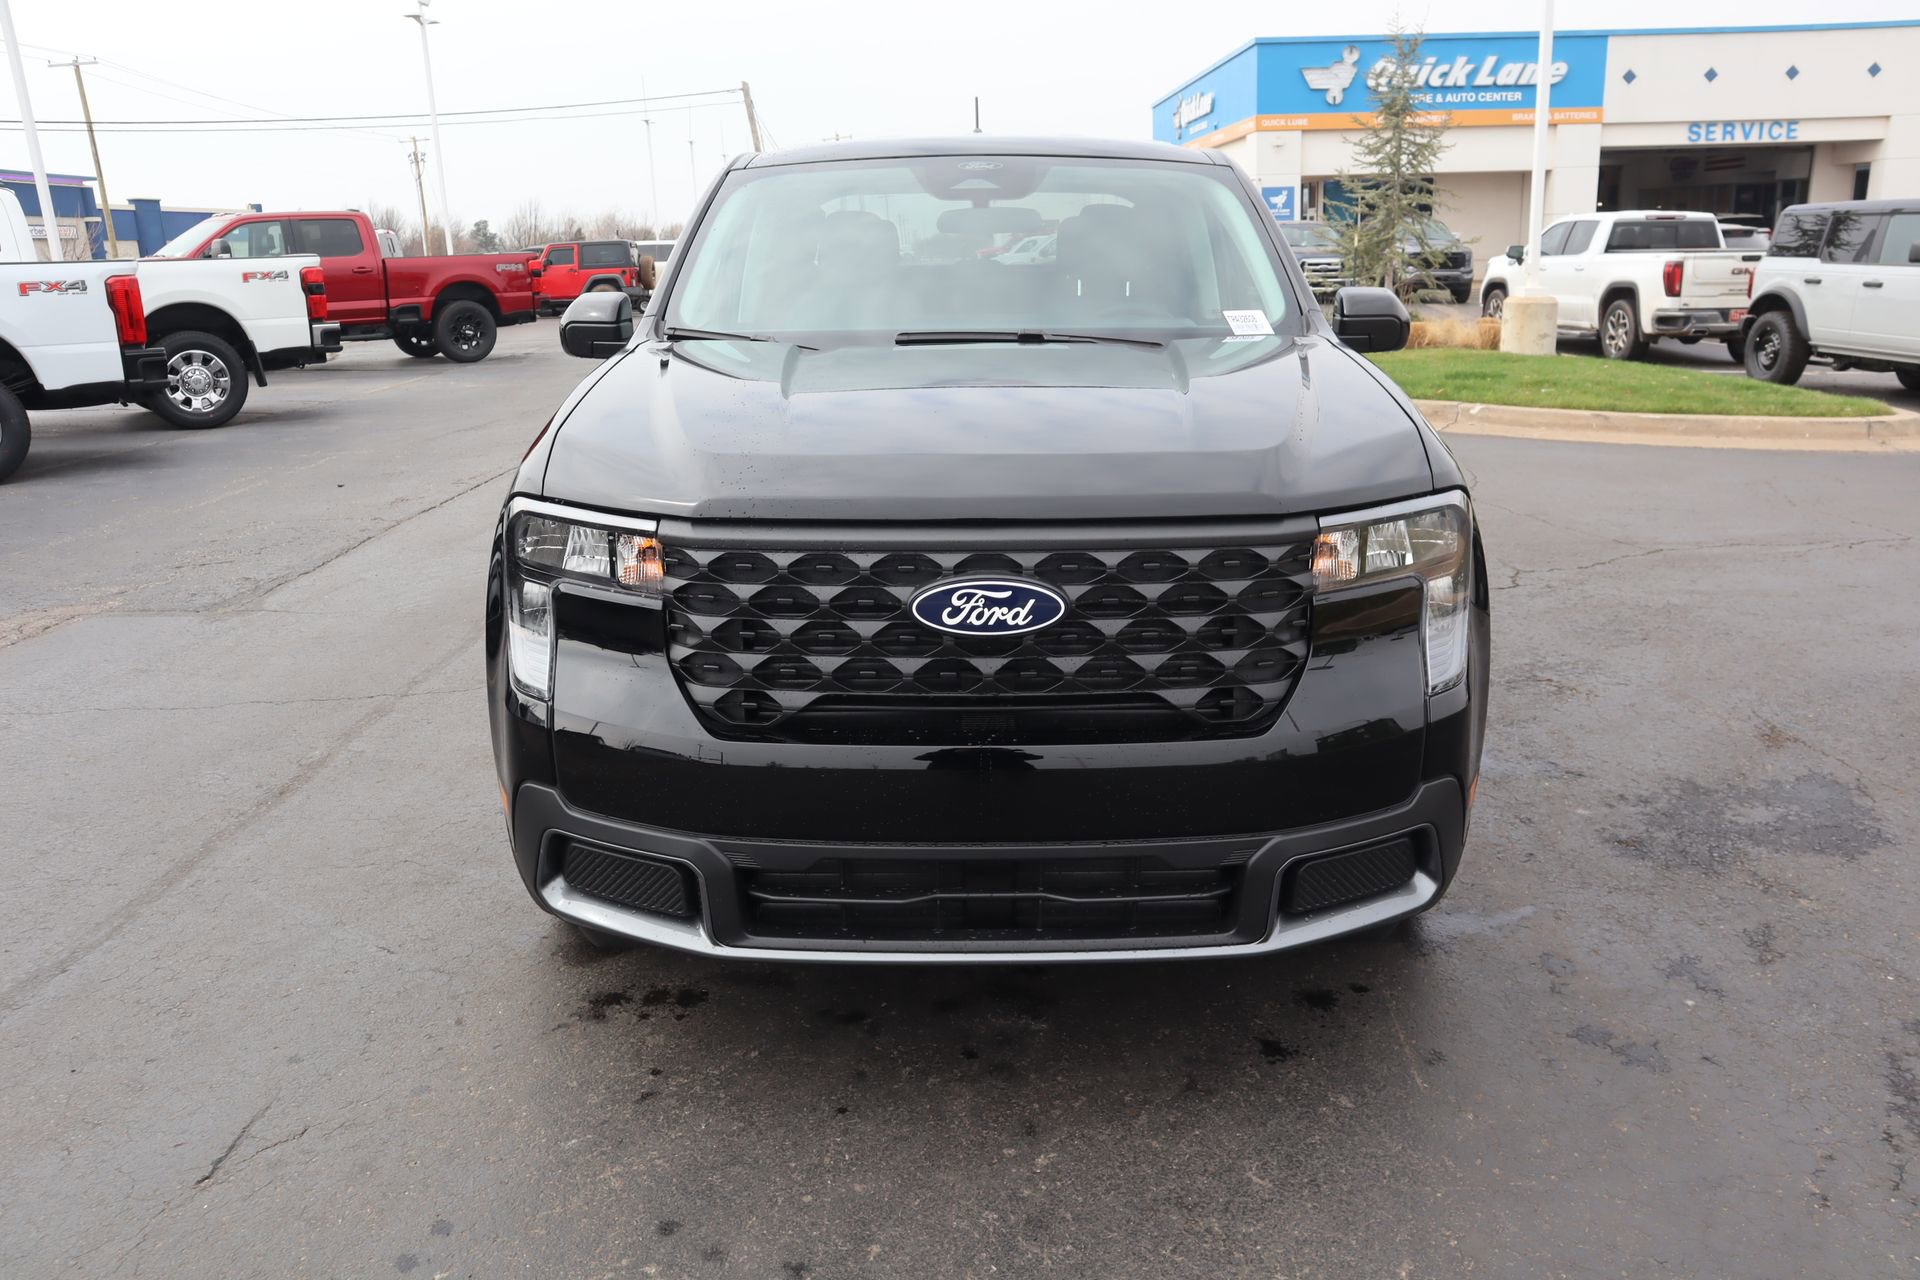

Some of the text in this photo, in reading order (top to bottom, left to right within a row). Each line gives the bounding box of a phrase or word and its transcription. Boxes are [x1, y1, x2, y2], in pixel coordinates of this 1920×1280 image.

[1471, 55, 1569, 87] Lane
[1436, 93, 1443, 103] &
[1445, 92, 1476, 103] AUTO
[1478, 91, 1522, 102] CENTER
[1261, 118, 1309, 127] QUICK LUBE
[1553, 111, 1598, 120] BATTERIES
[1687, 120, 1800, 142] SERVICE
[241, 270, 289, 283] FX4
[17, 280, 88, 297] FX4
[941, 588, 1036, 626] Ford
